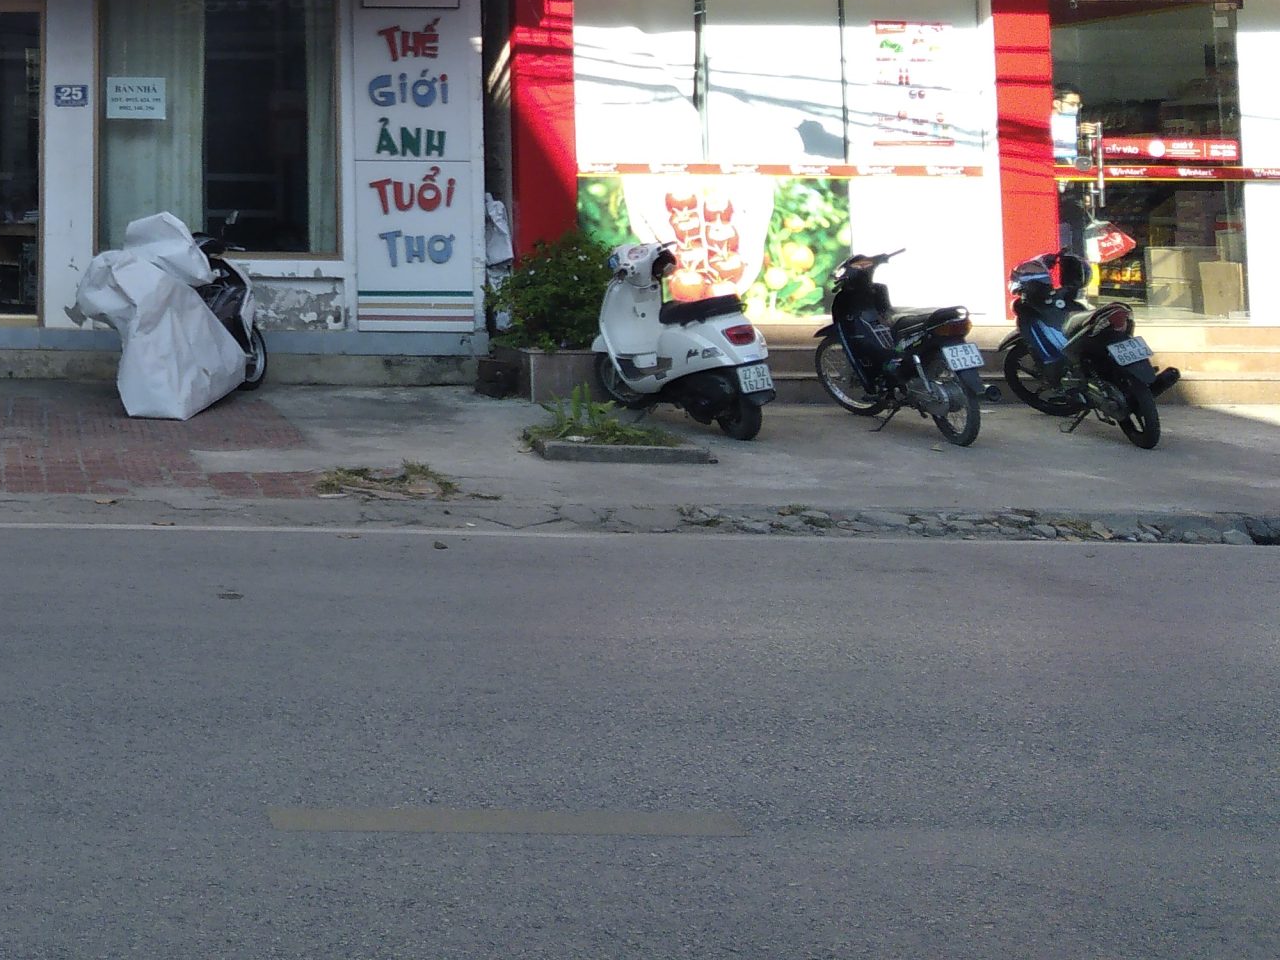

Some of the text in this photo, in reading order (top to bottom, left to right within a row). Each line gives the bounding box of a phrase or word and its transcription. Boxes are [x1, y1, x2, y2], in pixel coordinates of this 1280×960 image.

[376, 17, 441, 62] THẾ
[60, 87, 83, 101] 25
[376, 117, 446, 157] ẢNH
[379, 230, 456, 267] THƠ
